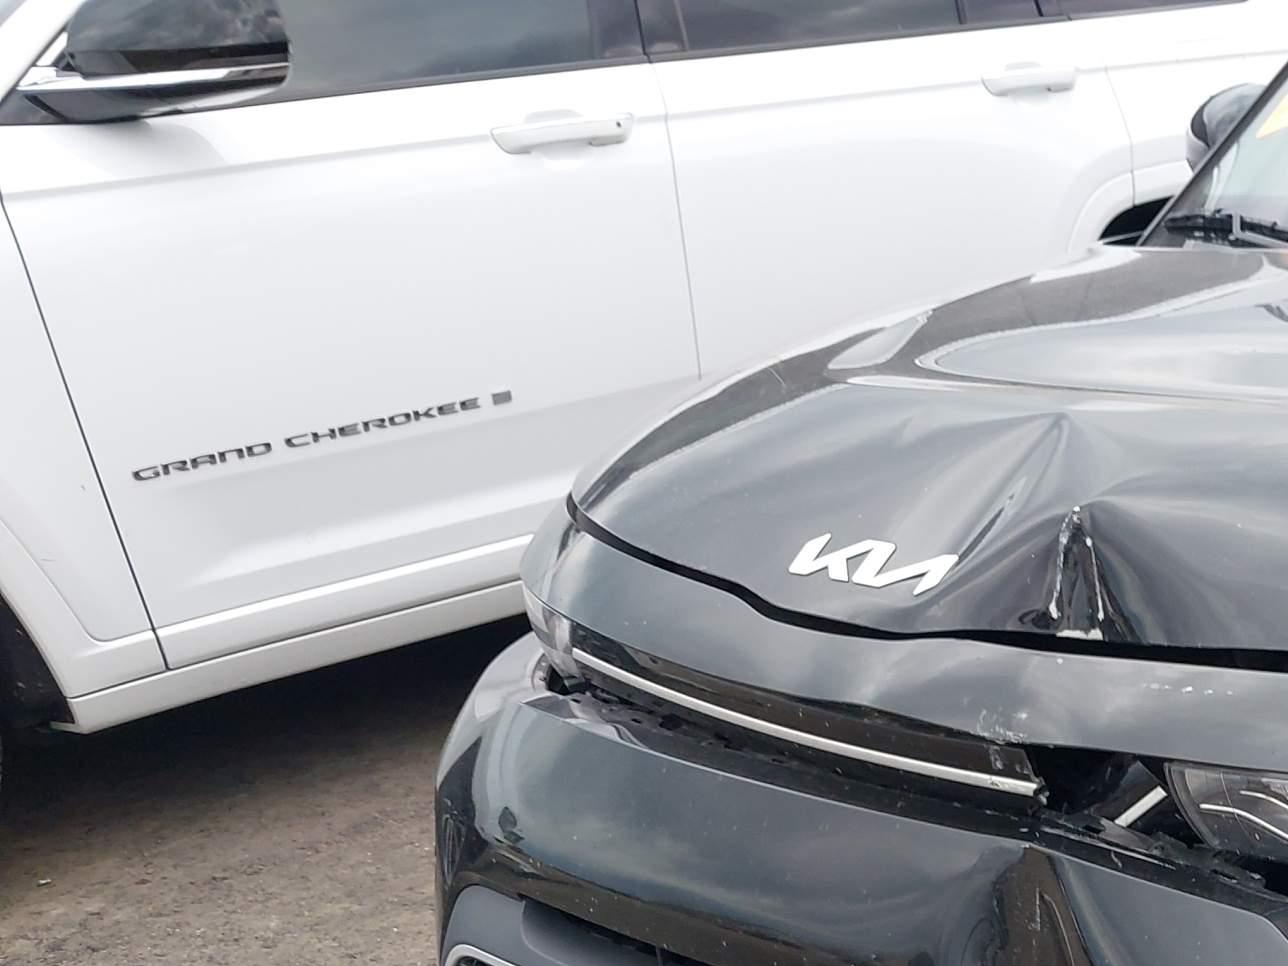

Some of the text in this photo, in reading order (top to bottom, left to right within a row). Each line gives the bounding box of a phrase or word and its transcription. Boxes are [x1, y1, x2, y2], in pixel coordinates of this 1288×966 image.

[132, 397, 480, 482] GRAND CHEROKEE
[788, 532, 960, 597] KIA
